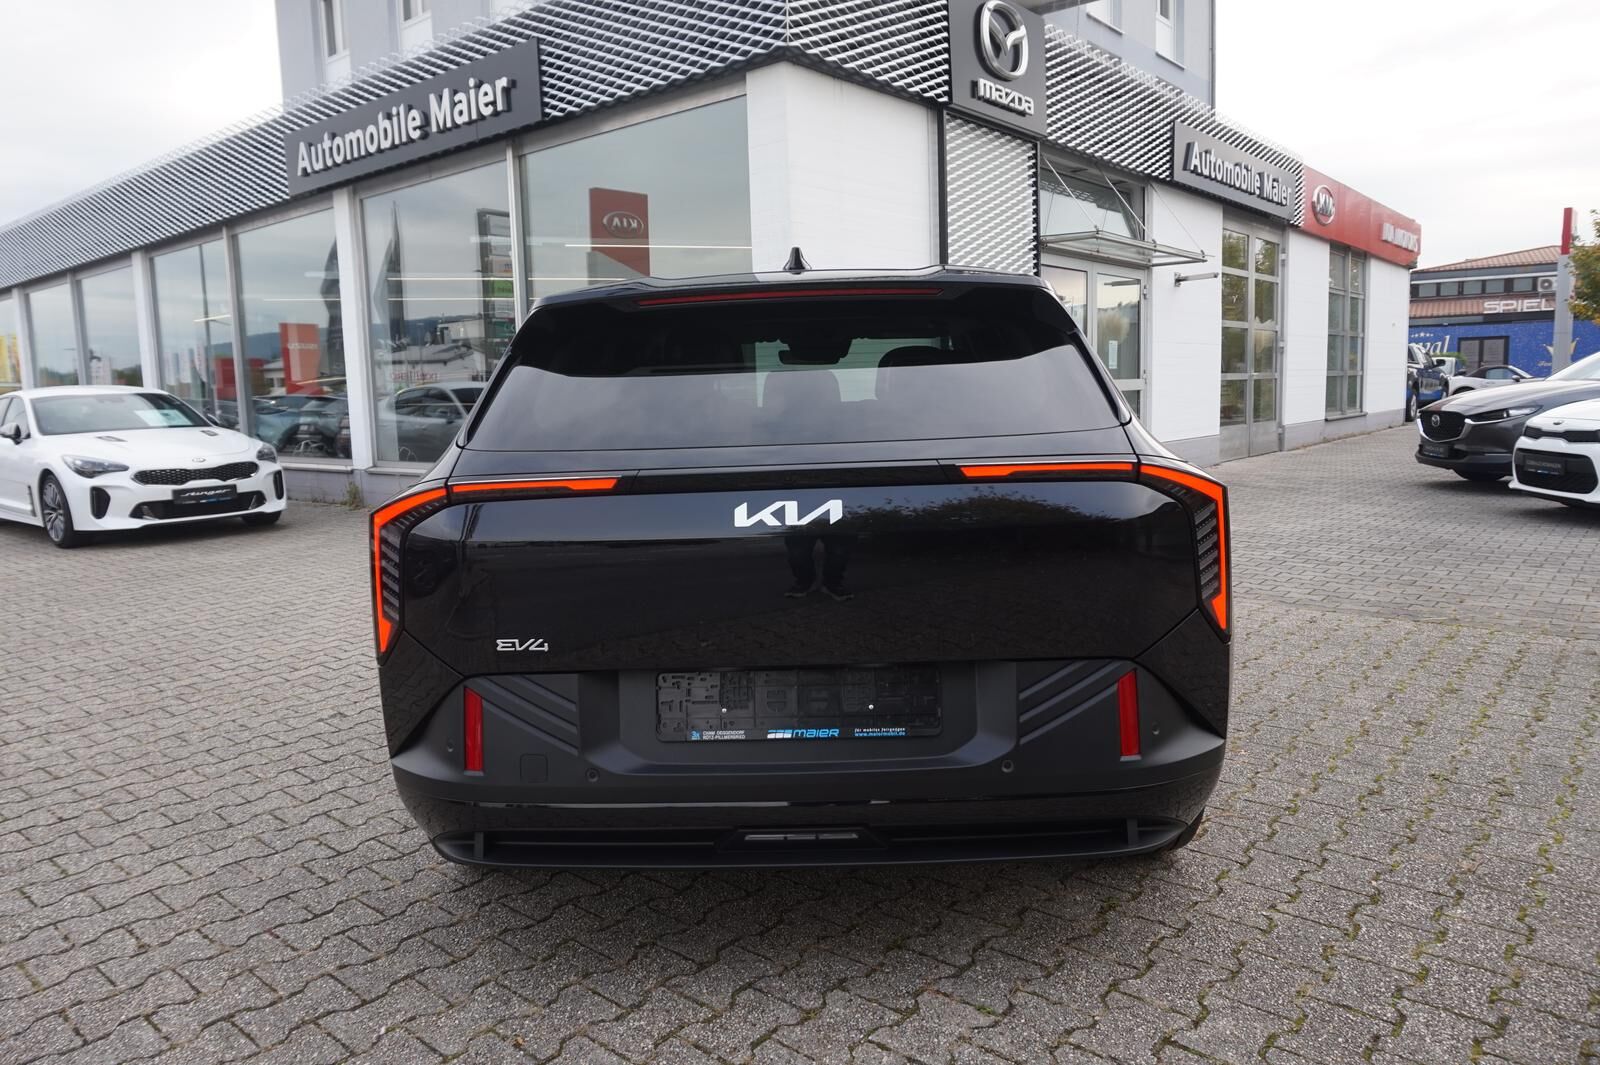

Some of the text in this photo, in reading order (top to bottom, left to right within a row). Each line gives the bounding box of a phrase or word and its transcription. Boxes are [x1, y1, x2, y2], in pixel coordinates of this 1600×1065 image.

[297, 77, 508, 176] Automobile Maier
[1190, 141, 1292, 206] Automobile Maier
[1483, 298, 1554, 314] SPIEL
[734, 499, 842, 527] KIA
[496, 638, 549, 652] EV4
